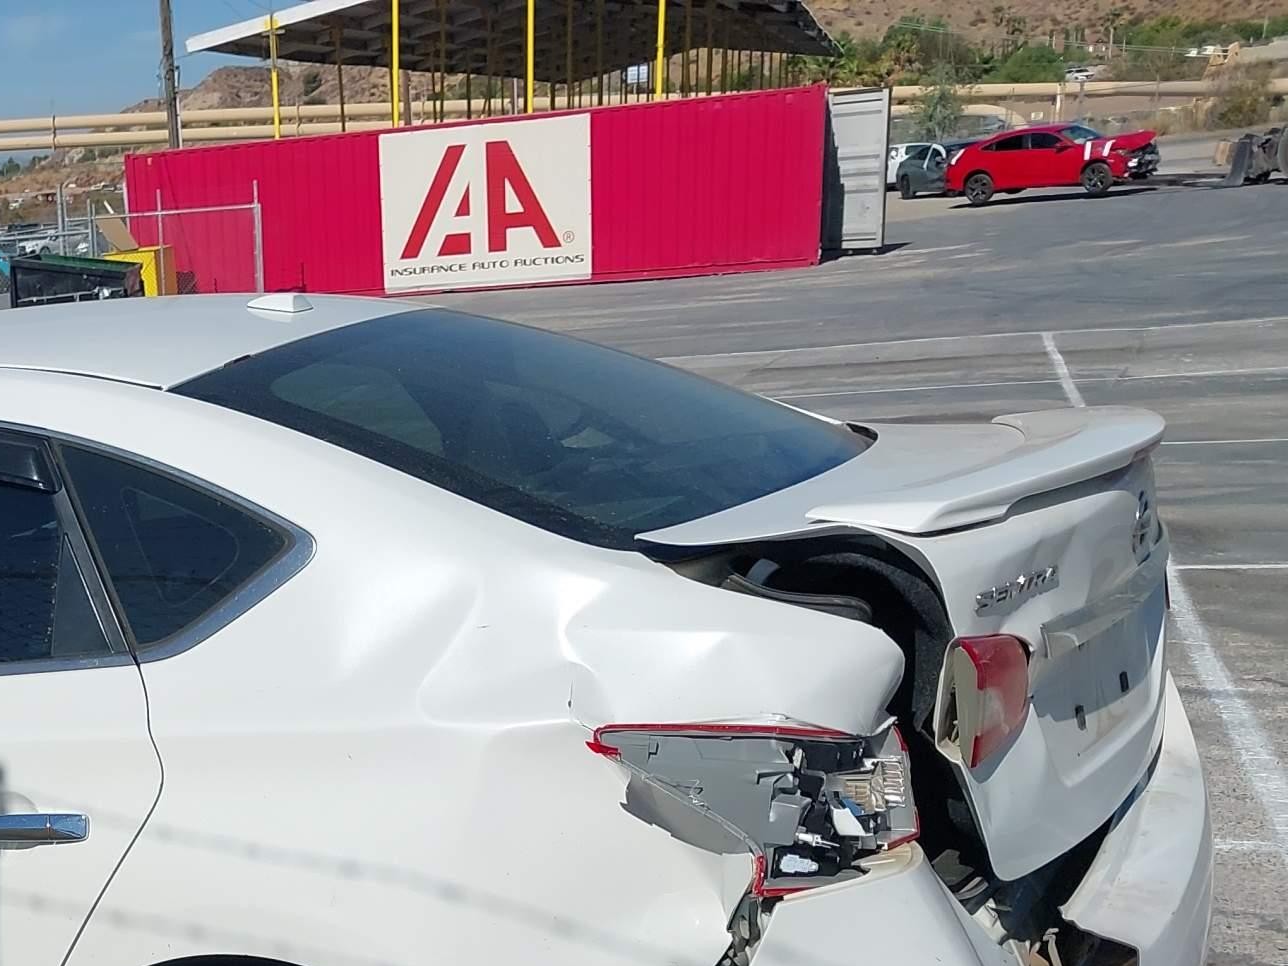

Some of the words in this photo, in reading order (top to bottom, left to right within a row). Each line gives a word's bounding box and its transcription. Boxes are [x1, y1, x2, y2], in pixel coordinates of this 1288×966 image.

[391, 262, 467, 277] INSURANCE
[472, 259, 509, 271] AUTO
[514, 254, 585, 267] AUCTIONS
